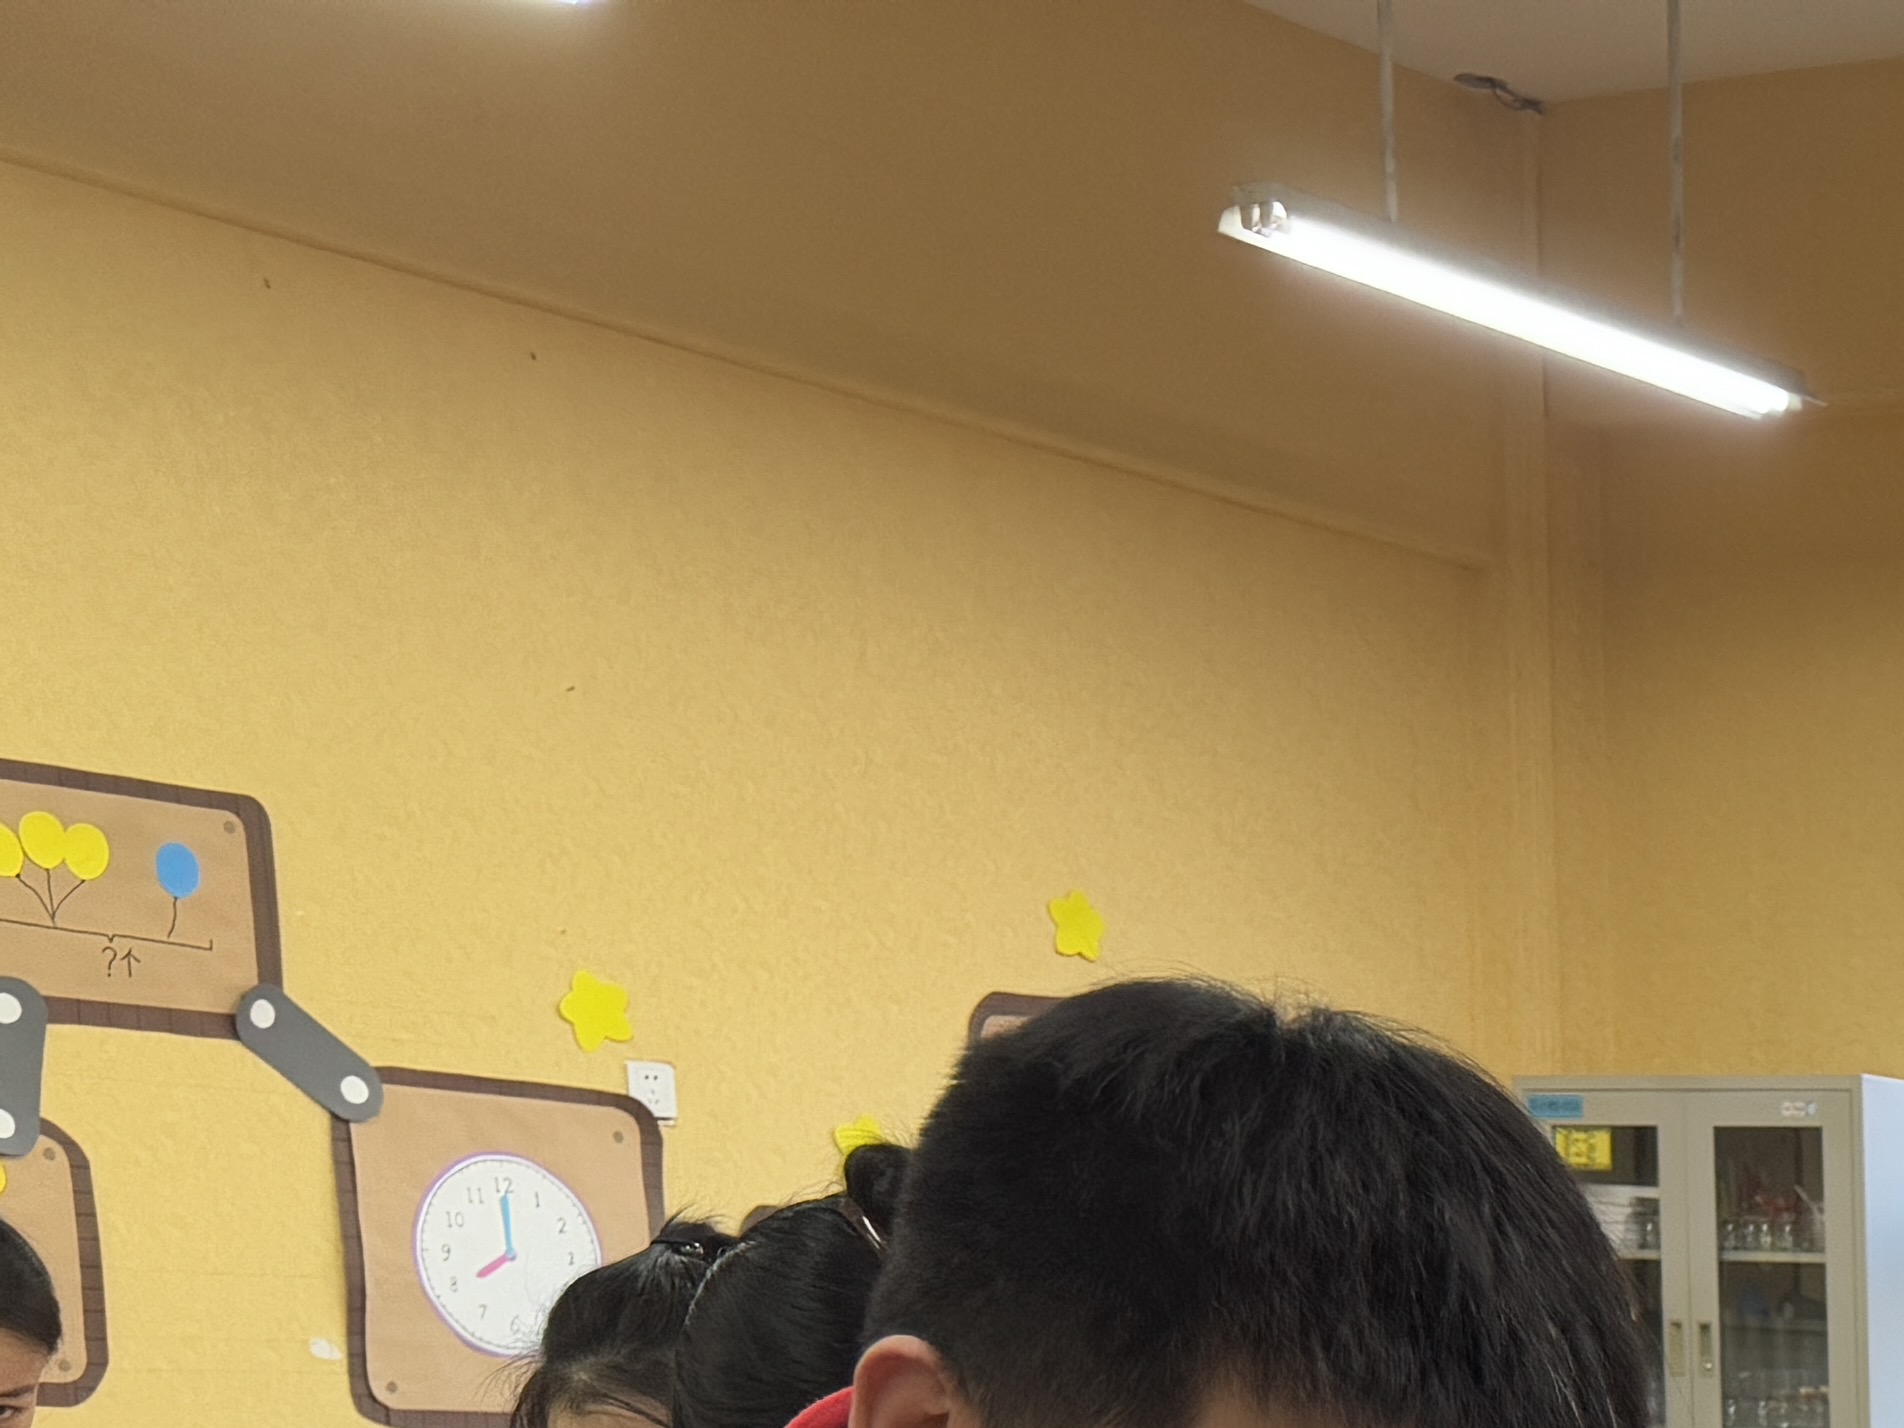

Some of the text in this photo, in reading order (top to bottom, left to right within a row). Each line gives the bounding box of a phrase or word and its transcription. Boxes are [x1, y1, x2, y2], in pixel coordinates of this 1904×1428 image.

[494, 1177, 514, 1194] 12
[466, 1188, 484, 1204] 11
[535, 1192, 541, 1208] 1
[446, 1211, 464, 1228] 10
[557, 1218, 567, 1234] 2
[441, 1244, 451, 1262] 9
[450, 1277, 458, 1293] 8
[478, 1304, 488, 1319] 7
